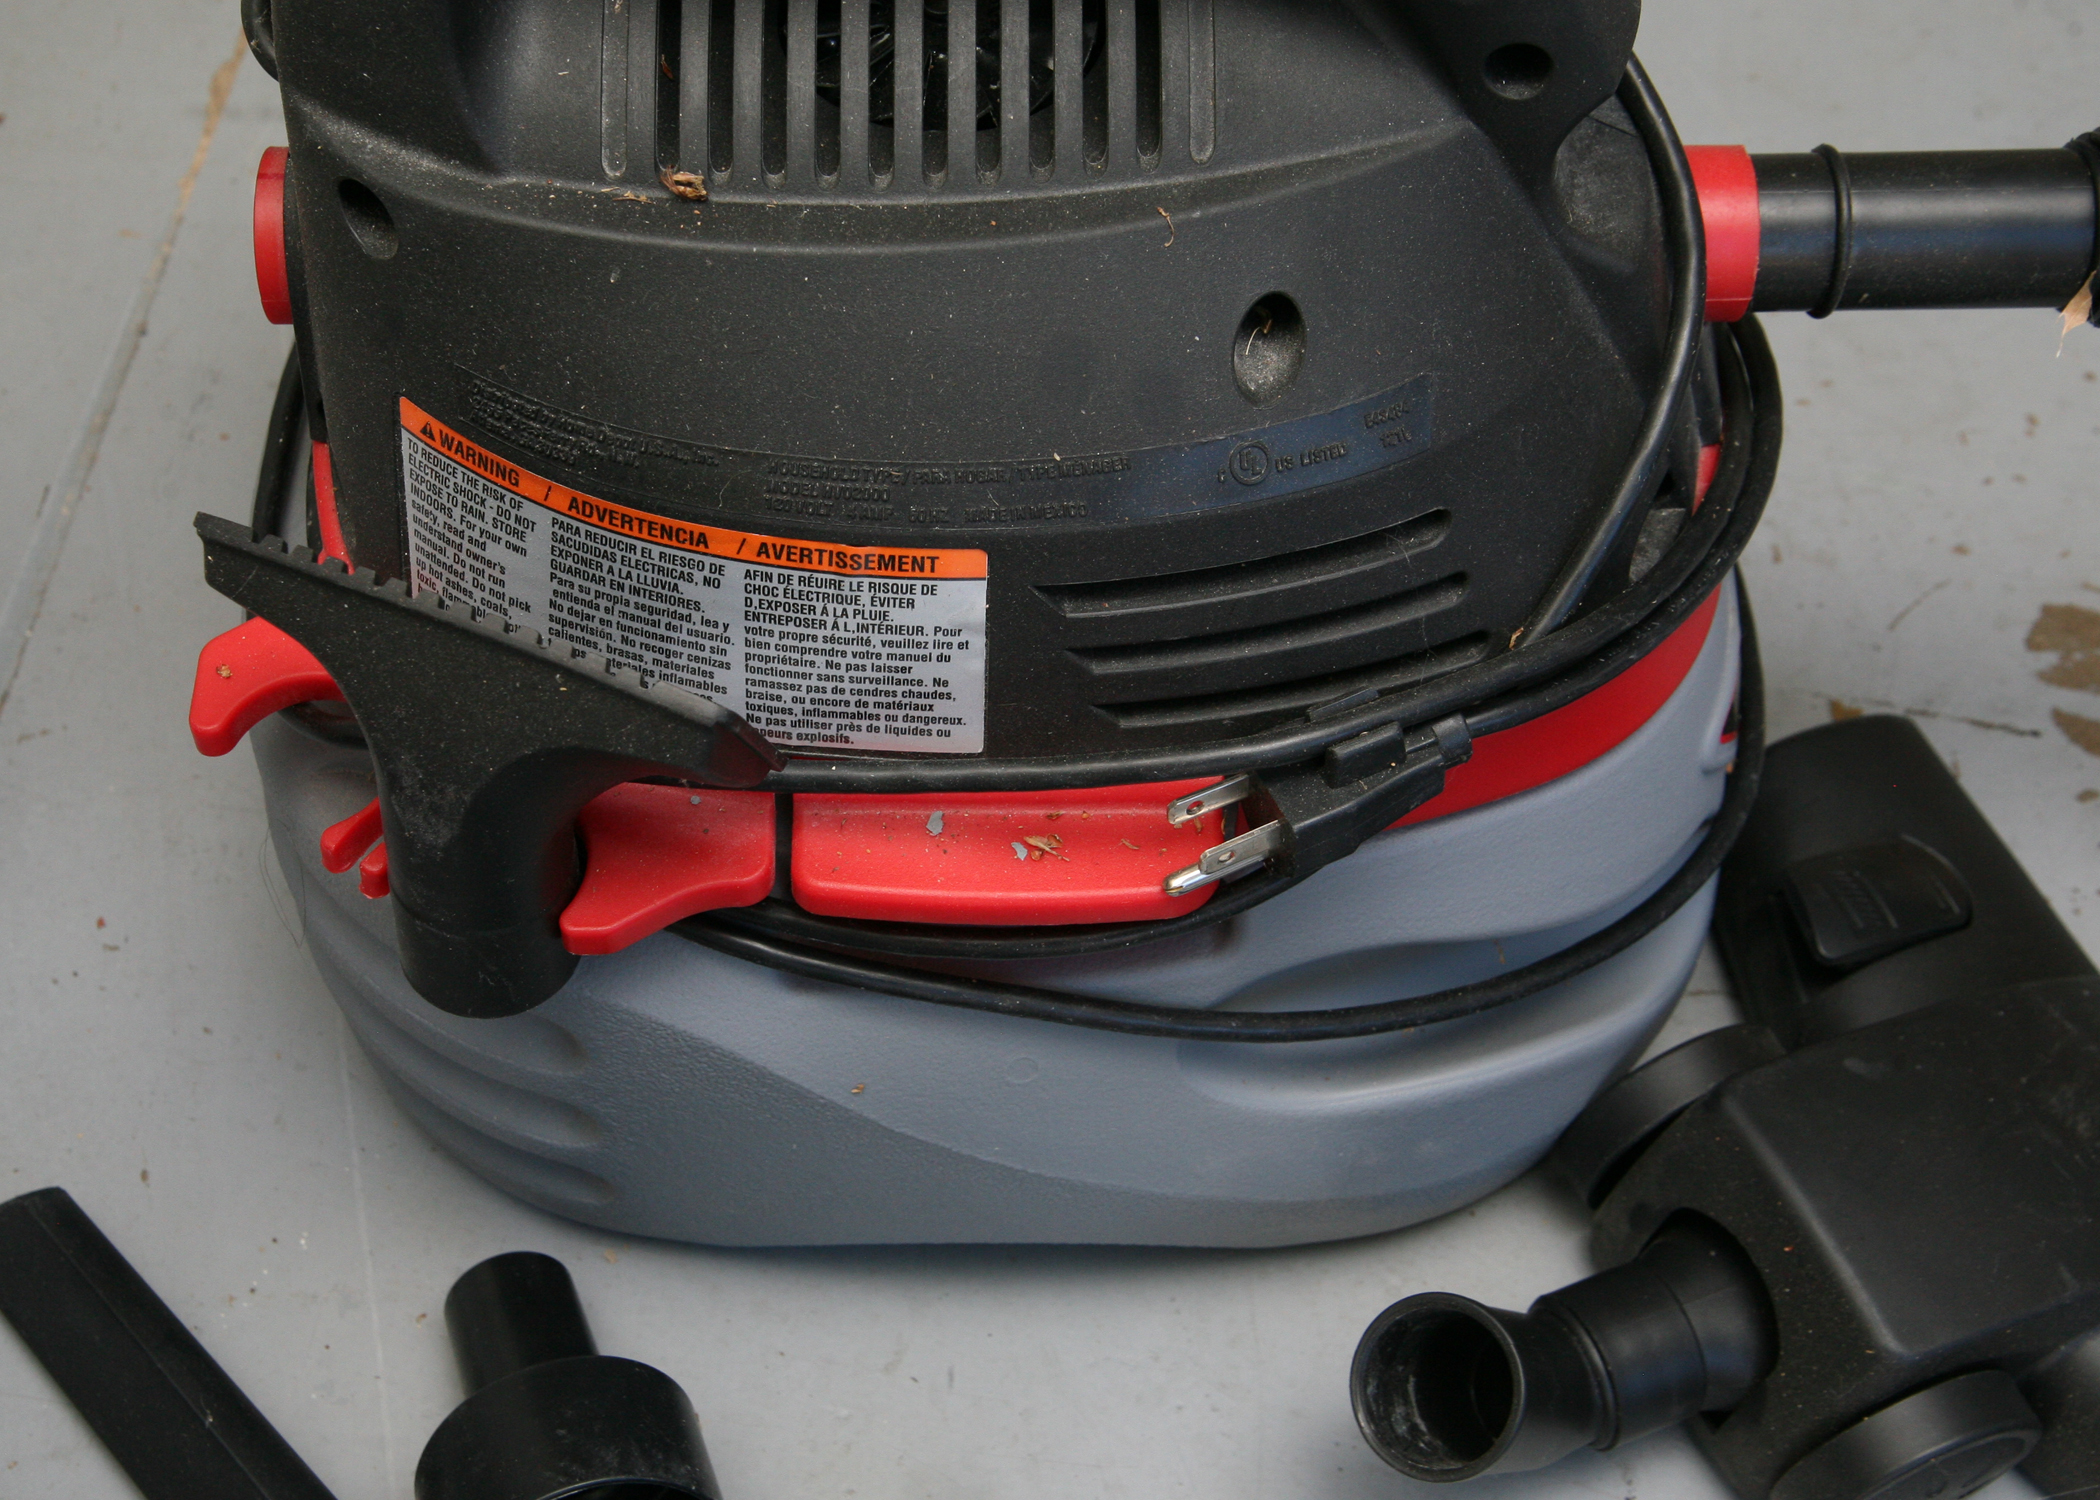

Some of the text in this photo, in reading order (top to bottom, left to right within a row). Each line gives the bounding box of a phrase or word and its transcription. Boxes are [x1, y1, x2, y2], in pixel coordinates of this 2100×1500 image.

[407, 438, 524, 511] TO REDUCE THE RISK OF
[408, 454, 537, 533] ELECTRIC SHOCK DO NOT
[439, 428, 520, 488] WARNING
[567, 496, 710, 549] ADVERTENCIA
[756, 541, 940, 573] AVERTISSEMENT
[409, 468, 527, 543] EXPOSE TO RAIN. STORE
[410, 484, 527, 557] INDOORS. For your own
[411, 499, 487, 552] safety, read and
[413, 514, 506, 575] understand owner's
[414, 527, 506, 589] manual. Do not run
[551, 517, 725, 576] PARA REDUCIR EL RIESGO DE
[551, 532, 721, 589] SACUDIDAS ELECTRICAS, NO
[551, 545, 684, 595] EXPONER A LA LLUVIA.
[415, 543, 531, 613] unattended. Do not pick
[416, 557, 427, 571] up
[429, 563, 443, 582] hot
[445, 575, 477, 603] ashes,
[480, 596, 512, 620] coals,
[550, 573, 730, 633] Para su propia seguridad, lea y
[551, 558, 705, 613] GUARDAR EN INTERIORES.
[744, 569, 938, 596] AFIN DE RÉUIRE LE RISQUE DE
[744, 583, 915, 610] CHOC ÉLECTRIQUE, ÉVITER
[549, 599, 728, 657] No dejar en funcionamiento sin
[553, 588, 735, 646] entienda el manual del usuario.
[744, 610, 827, 630] ENTREPOSER
[933, 625, 963, 637] Pour
[744, 625, 969, 650] votre propre sécurité, veuillez lire et
[833, 607, 849, 619] LA
[853, 610, 894, 622] PLUIE.
[548, 614, 732, 671] supervisión. No recoger cenizas
[548, 626, 602, 653] calientes,
[606, 643, 648, 666] brasas,
[652, 657, 715, 680] materiales
[744, 637, 951, 663] bien comprendre votre manuel du
[744, 651, 913, 675] propriétaire. Ne pas laisser
[658, 671, 728, 695] inflamables
[744, 662, 949, 688] fonctionner sans surveillance. Ne
[745, 677, 957, 702] ramassez pas de cendres chaudes,
[745, 688, 934, 712] braise, ou encore de matériaux
[745, 701, 967, 727] toxiques, inflammables ou dangereux.
[745, 712, 951, 738] Ne pas utiliser près de liquides ou
[796, 732, 854, 745] explosifs.
